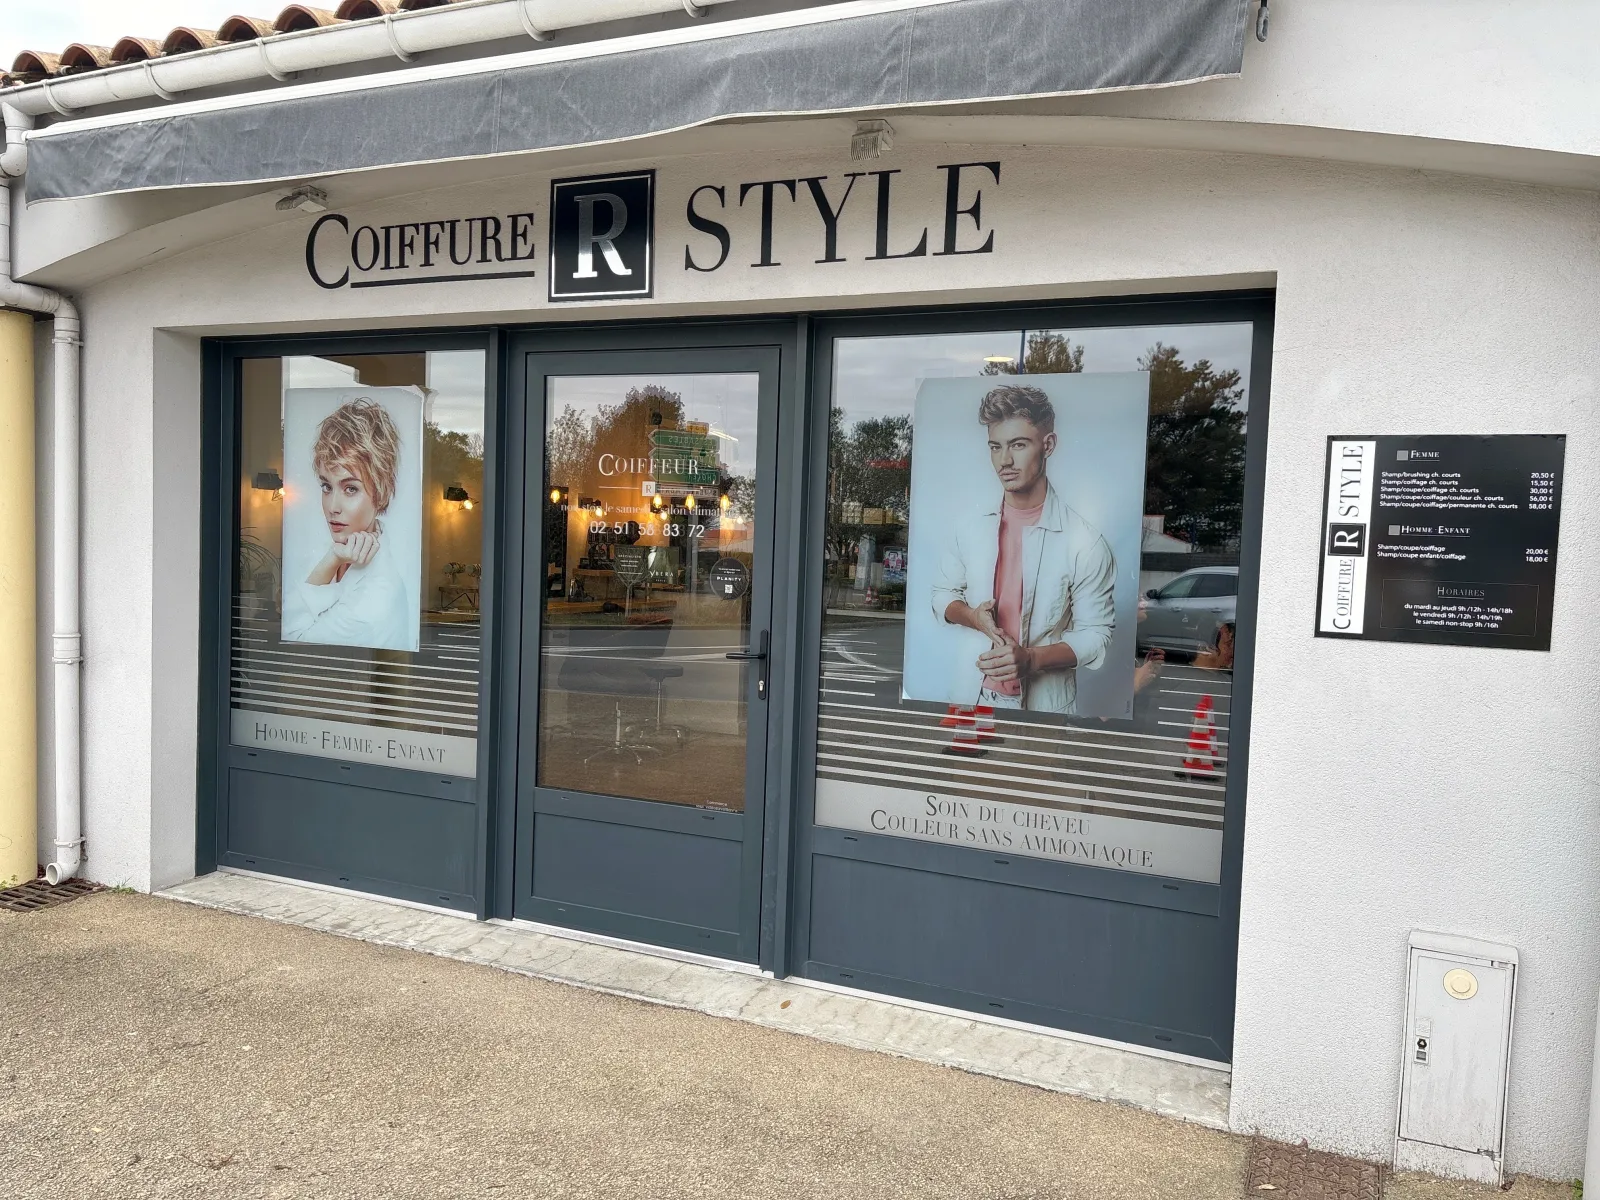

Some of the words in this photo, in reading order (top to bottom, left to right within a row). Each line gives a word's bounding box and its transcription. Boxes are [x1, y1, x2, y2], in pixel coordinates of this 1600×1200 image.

[305, 213, 535, 289] COIFFURE
[573, 193, 632, 279] R
[684, 161, 1001, 272] STYLE
[598, 453, 699, 477] COIFFEUR
[1381, 471, 1430, 479] Shamp/brushing
[1338, 445, 1364, 518] STYLE
[1380, 486, 1448, 494] Shamp/coupe/coiffage
[1380, 493, 1473, 502] Shamp/coupe/coiffage/couleur
[560, 503, 577, 511] no
[605, 502, 614, 513] le
[661, 504, 686, 516] salon
[1379, 500, 1487, 509] Shamp/coupe/coiffage/permanente
[590, 521, 607, 534] 02
[613, 521, 629, 535] 51
[638, 523, 655, 536] 58
[662, 523, 680, 537] 83
[688, 524, 705, 538] 72
[1401, 525, 1433, 534] HOMME
[1438, 525, 1471, 534] ENFANT
[1333, 529, 1360, 549] R
[1377, 543, 1446, 553] Shamp/coupe/coiffage
[1376, 550, 1418, 558] Shamp/coupe
[1419, 552, 1466, 561] enfant/coiffage
[1437, 586, 1485, 597] HORAIRES
[1440, 604, 1457, 612] jeudi
[1445, 620, 1474, 628] non-stop
[255, 722, 308, 745] HOMME
[321, 730, 373, 754] FEMME
[387, 739, 446, 763] ENFANT
[925, 795, 969, 819] SOIN
[978, 805, 1004, 823] DU
[1012, 811, 1091, 836] CHEVEU
[870, 809, 959, 840] COULEUR
[965, 826, 1013, 847] SANS
[1019, 834, 1153, 868] AMMONIAQUE
